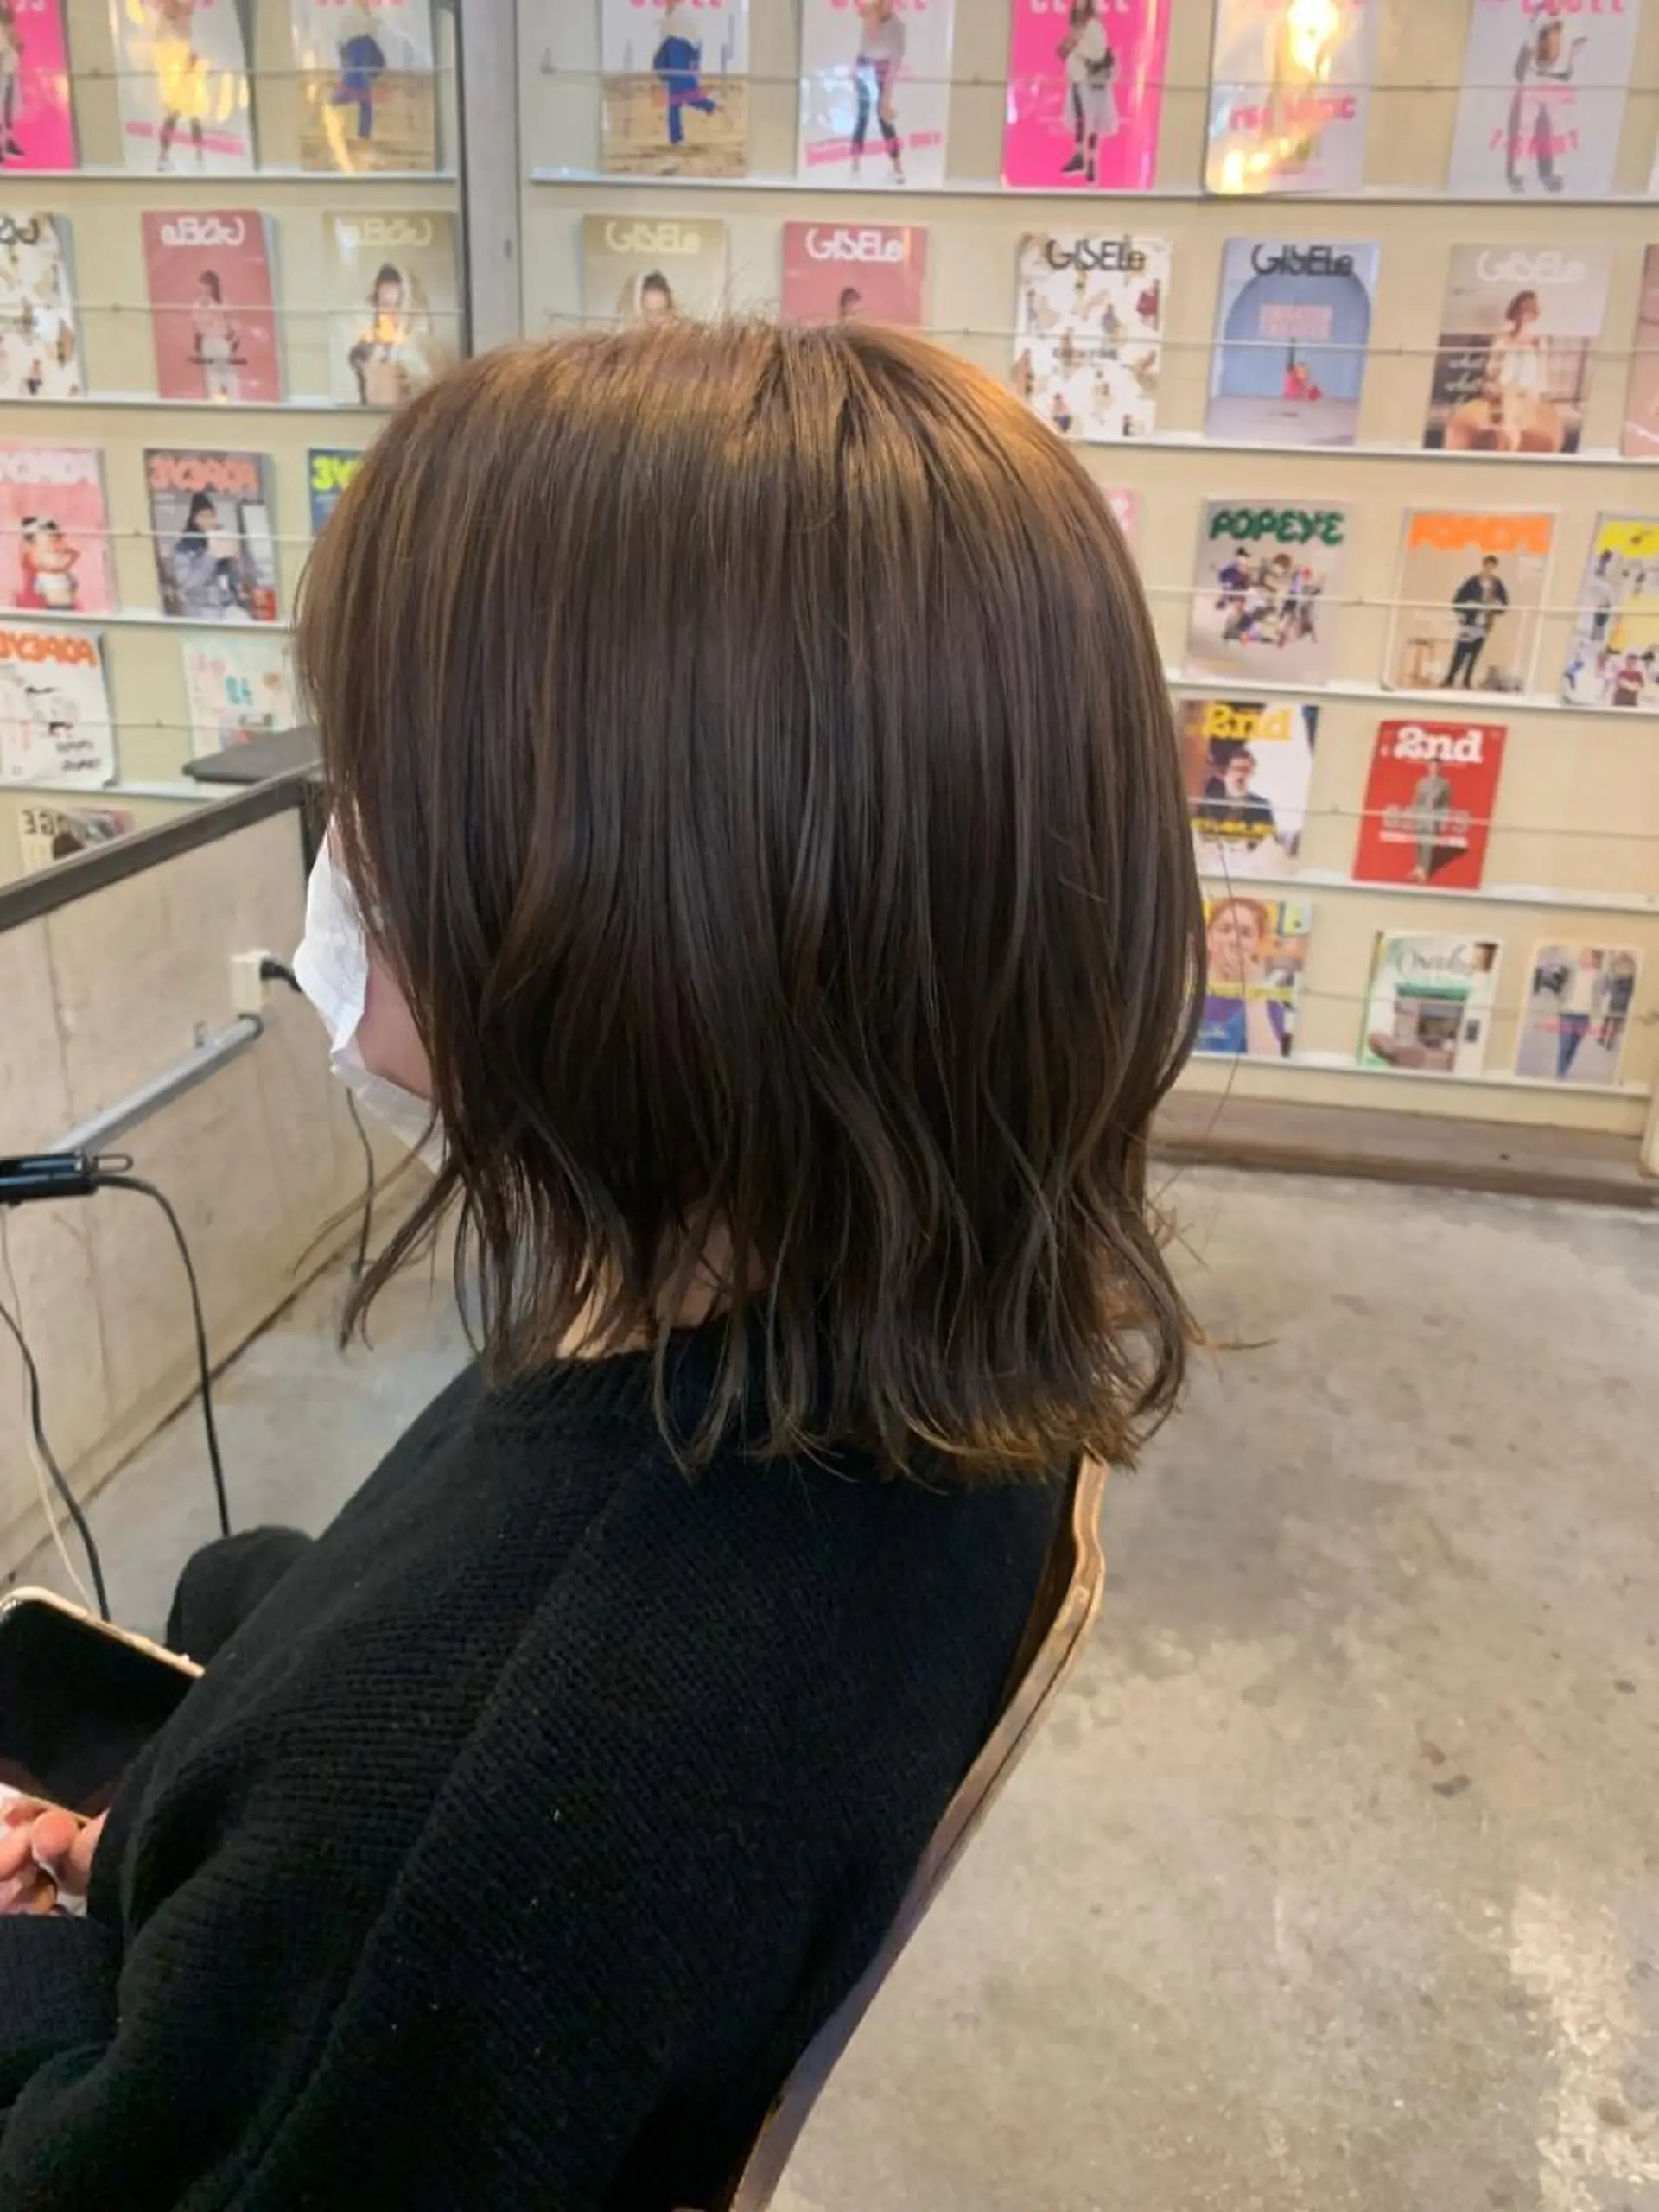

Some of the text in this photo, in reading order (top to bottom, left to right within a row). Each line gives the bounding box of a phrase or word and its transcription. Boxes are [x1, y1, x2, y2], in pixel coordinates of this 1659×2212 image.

[1210, 507, 1344, 547] POPEYE
[1202, 704, 1293, 741] 2nd
[1394, 725, 1484, 764] 2nd
